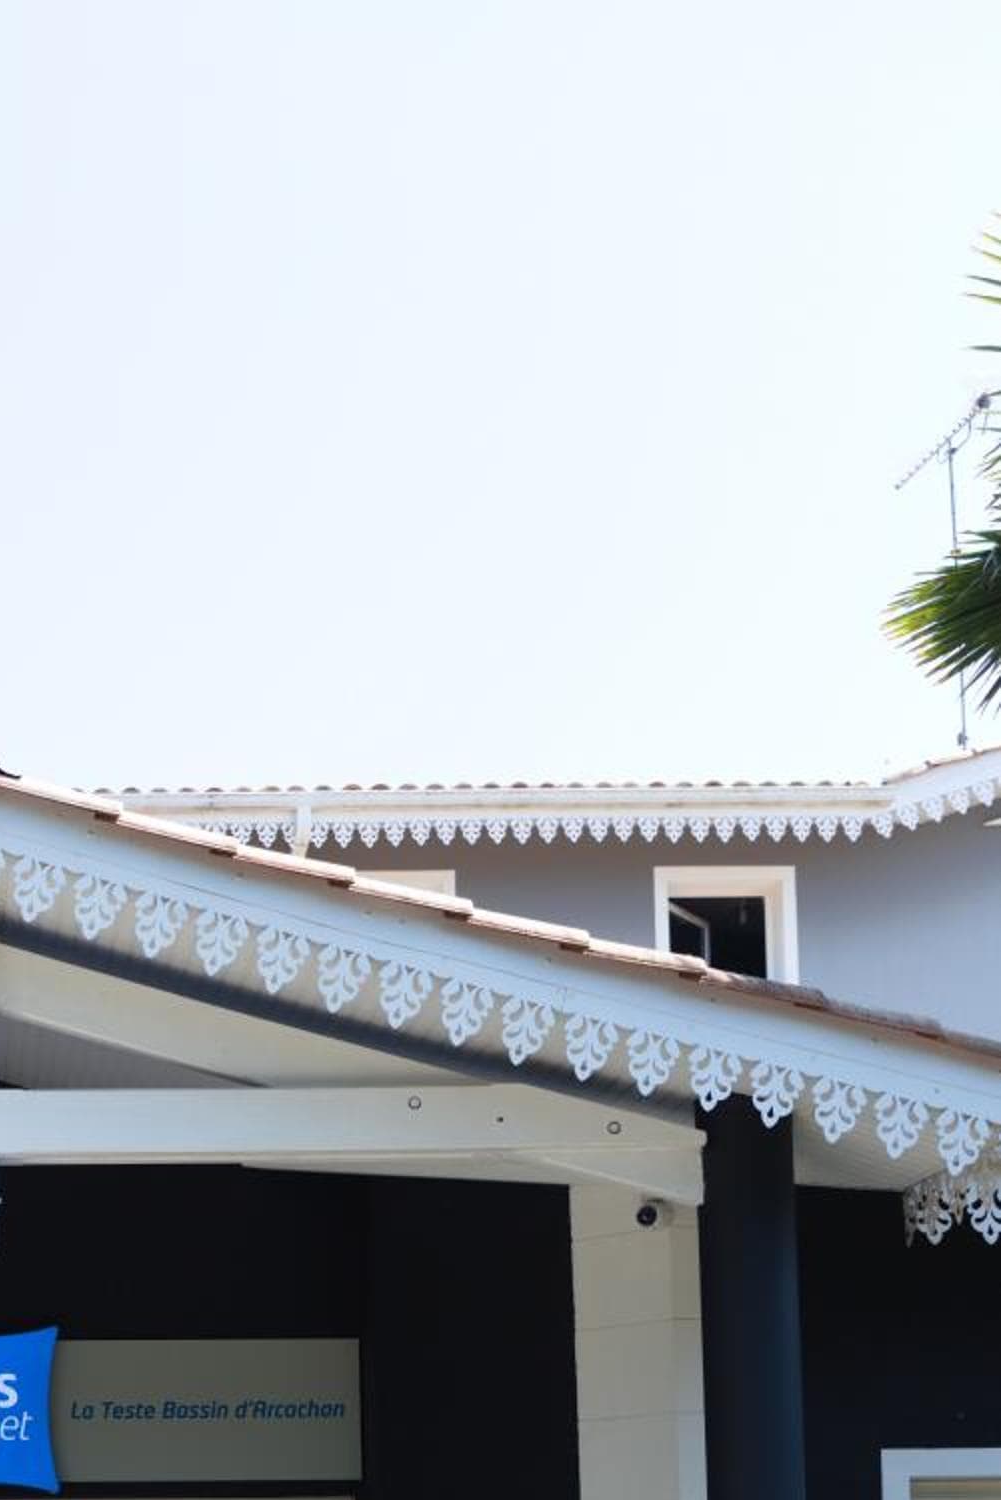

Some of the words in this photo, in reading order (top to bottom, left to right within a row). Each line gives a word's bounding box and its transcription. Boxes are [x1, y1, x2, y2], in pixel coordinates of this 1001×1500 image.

[70, 1401, 94, 1420] La
[101, 1401, 156, 1420] Teste
[162, 1401, 229, 1420] Bassin
[234, 1399, 346, 1419] d'Arcachon
